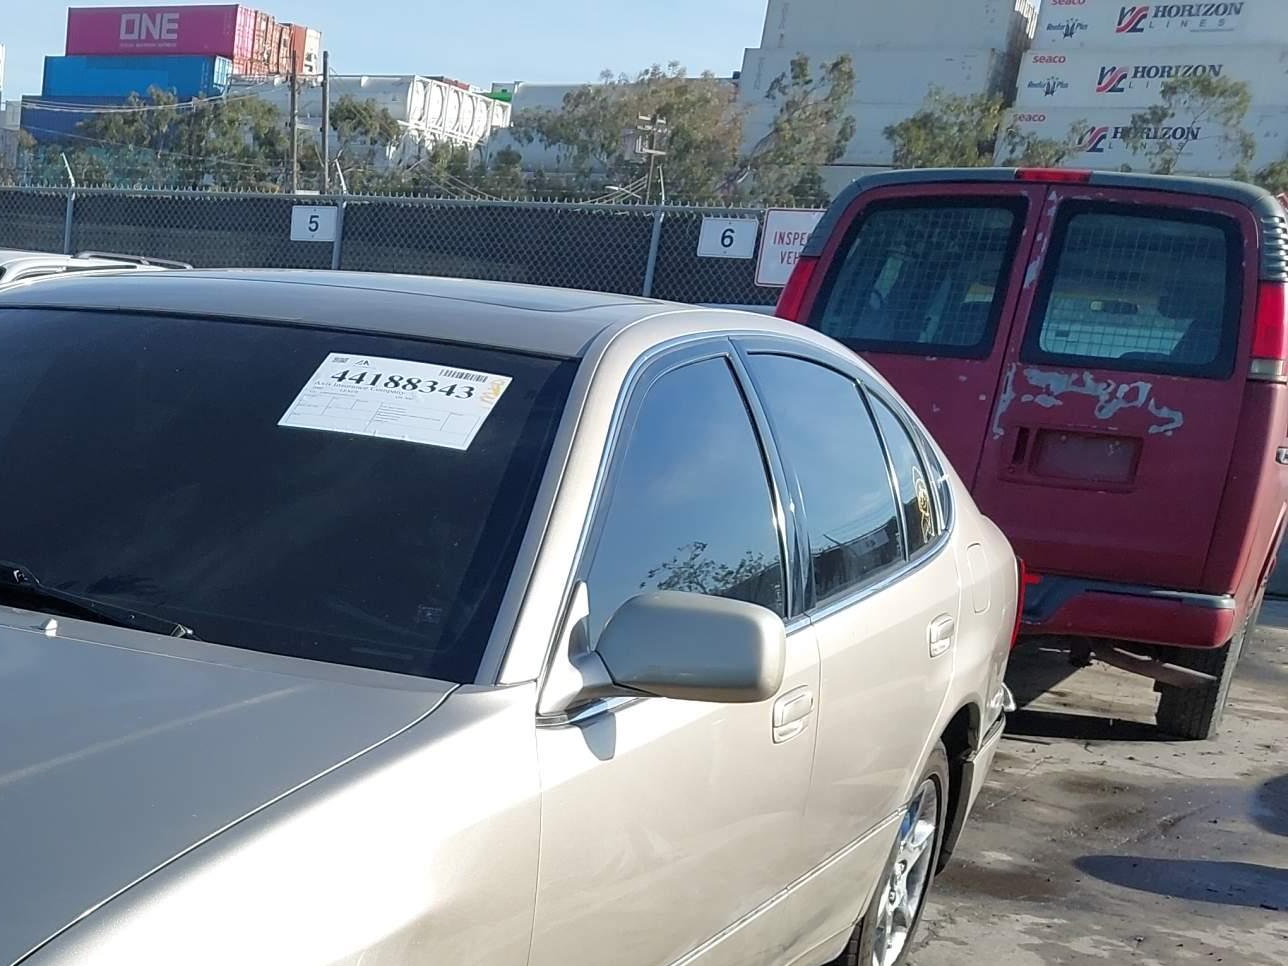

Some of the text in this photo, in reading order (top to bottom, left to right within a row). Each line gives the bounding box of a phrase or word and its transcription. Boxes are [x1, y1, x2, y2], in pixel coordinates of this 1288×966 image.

[1152, 2, 1245, 18] HORIZON
[120, 13, 179, 40] ONE
[1149, 18, 1227, 29] LINES
[1032, 54, 1066, 64] seaco
[1131, 64, 1223, 80] HORIZON
[1013, 113, 1046, 122] seaco
[1112, 126, 1201, 140] HRIZON
[308, 215, 319, 232] 5
[720, 228, 735, 248] 6
[331, 370, 475, 399] 44188343
